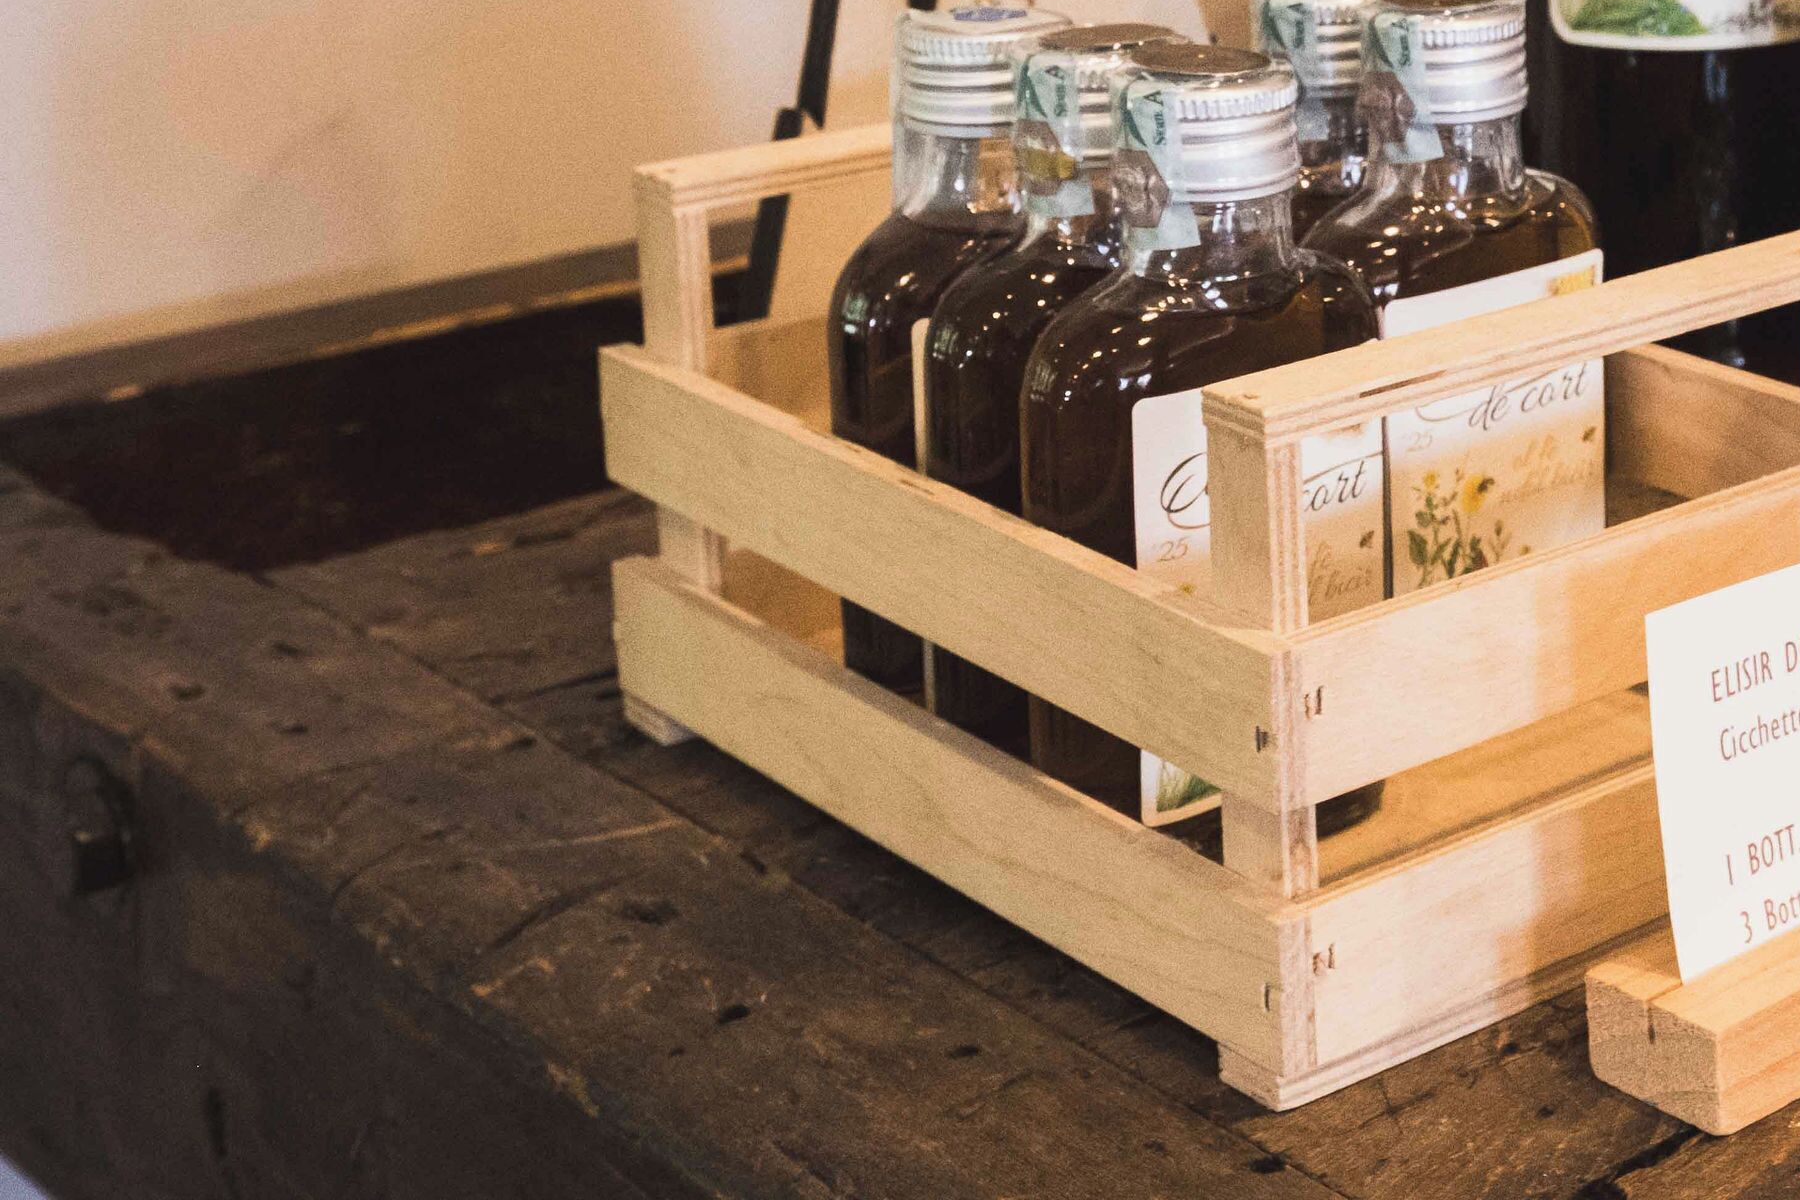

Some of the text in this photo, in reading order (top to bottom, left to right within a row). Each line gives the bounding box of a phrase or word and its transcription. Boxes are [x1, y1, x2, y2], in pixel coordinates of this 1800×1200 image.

[1711, 650, 1773, 703] ELISIR
[1726, 853, 1734, 886] 1
[1740, 910, 1753, 944] 3
